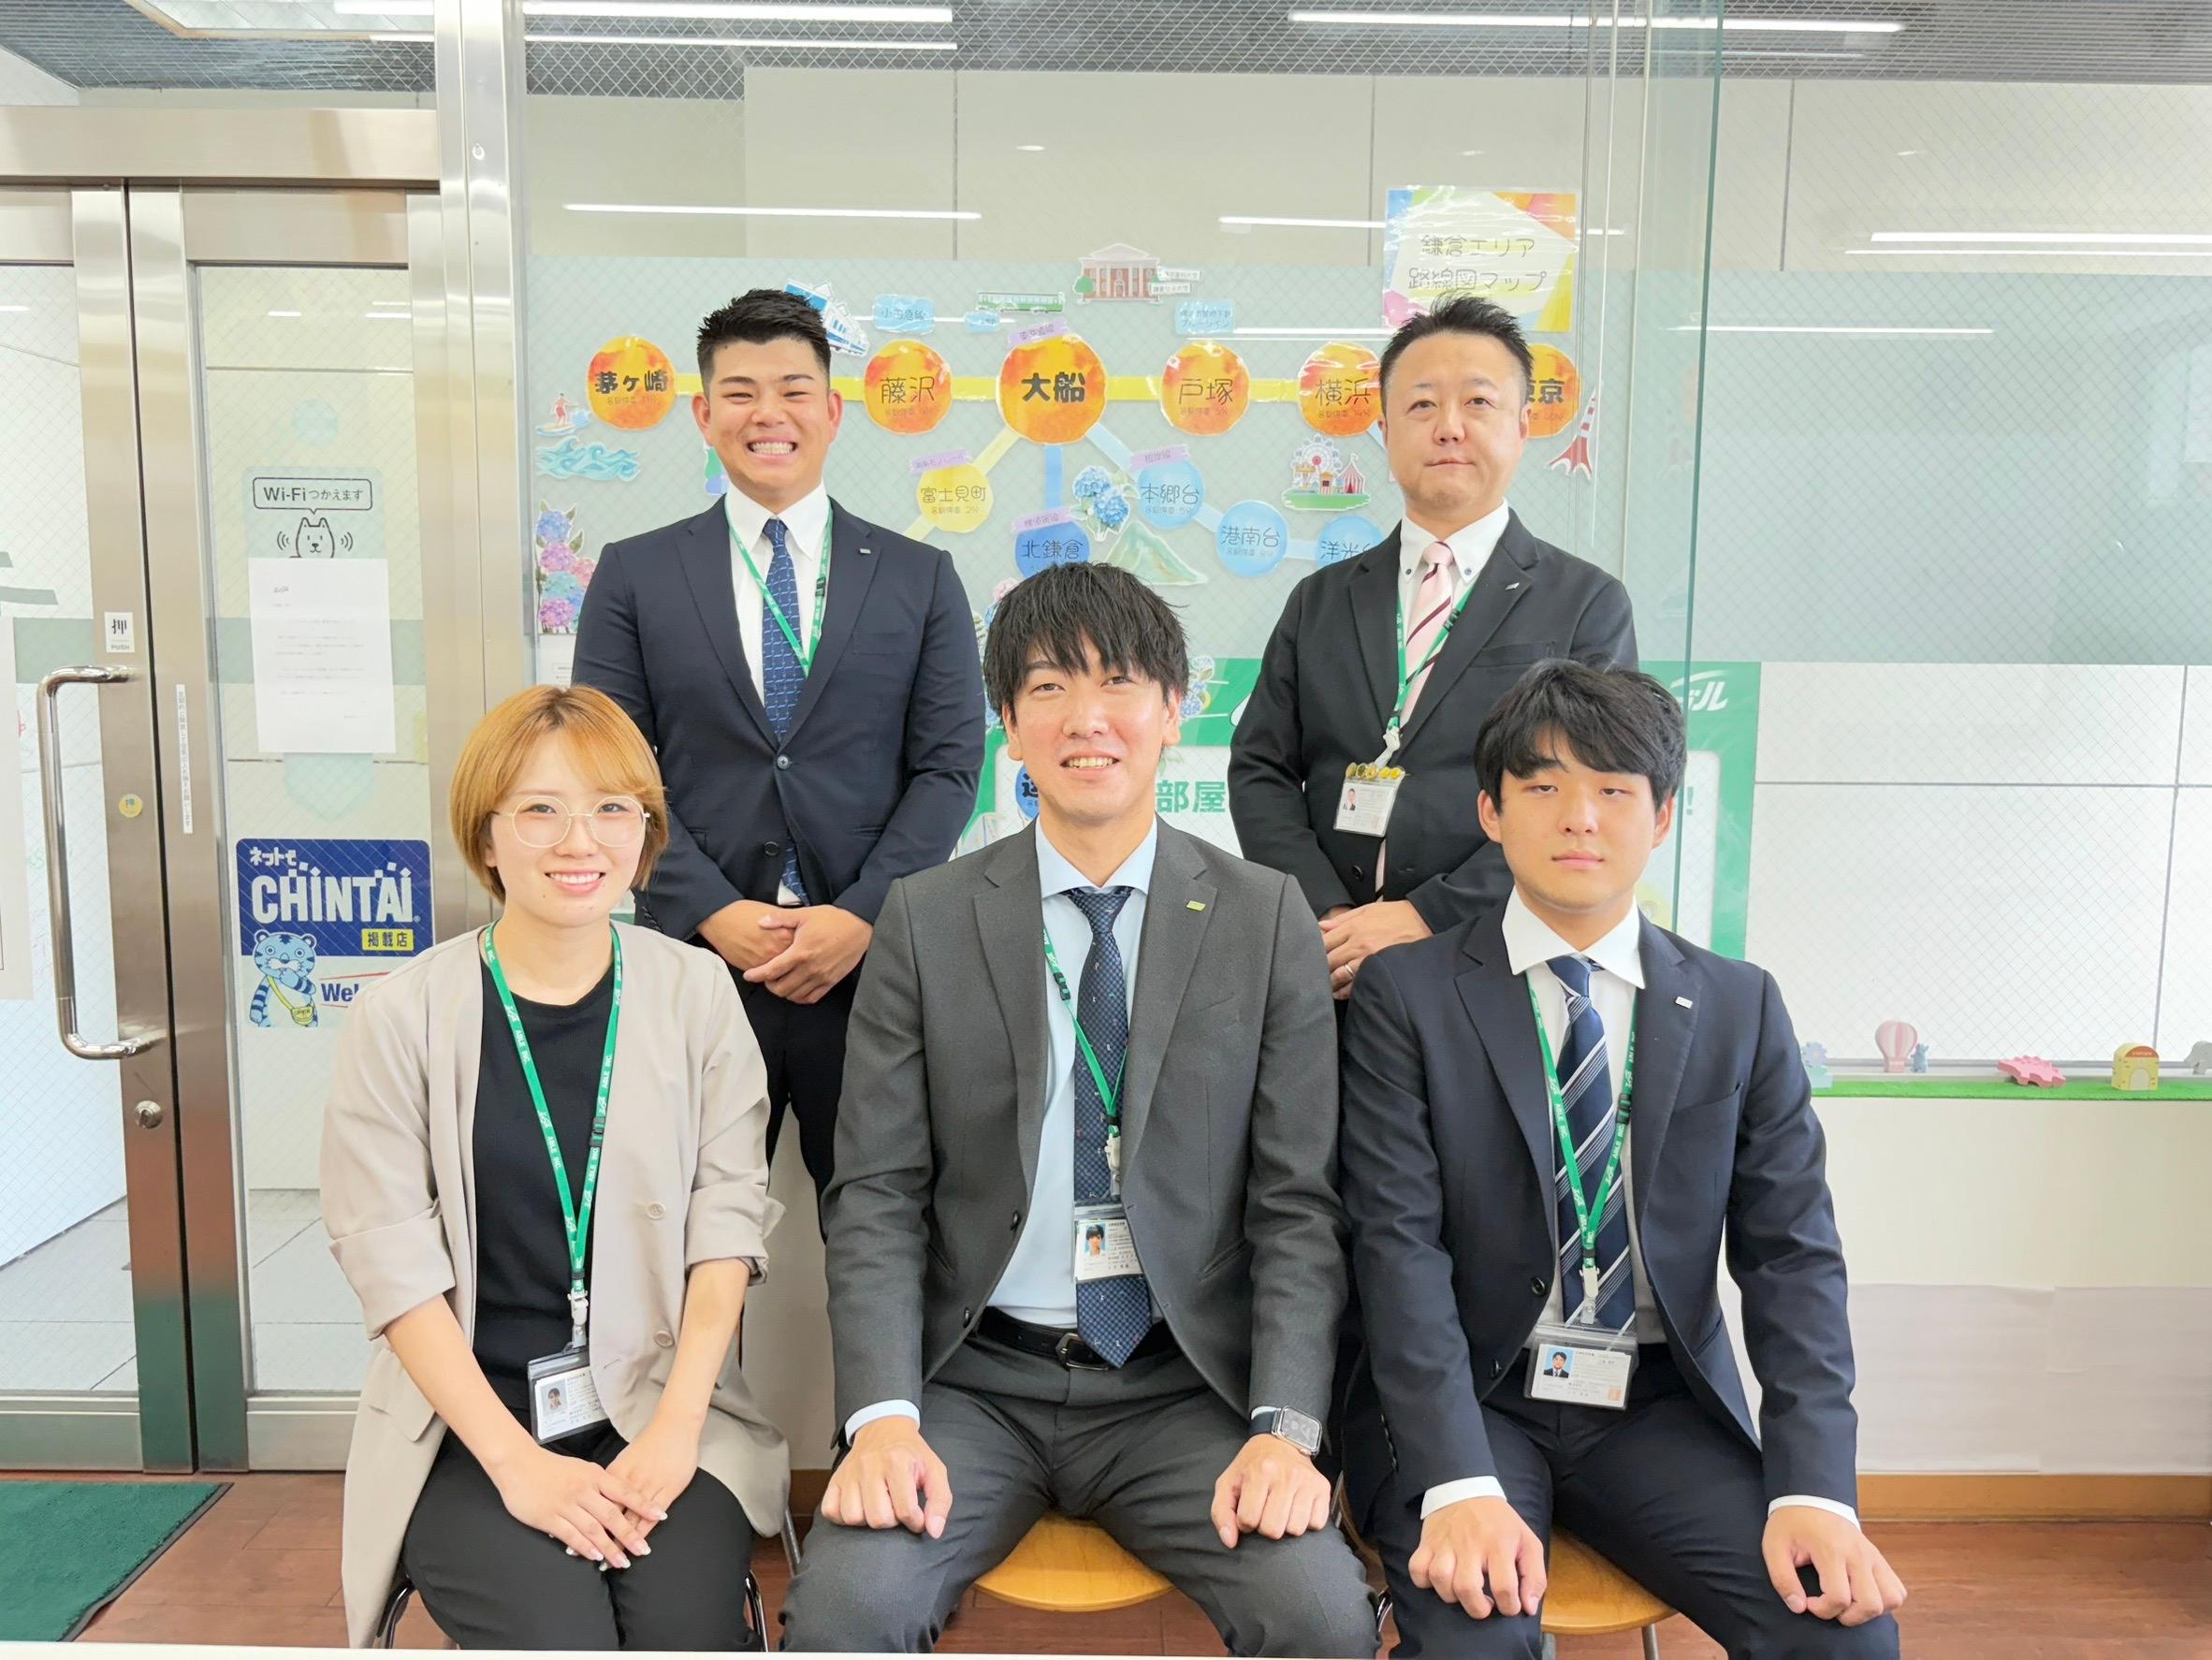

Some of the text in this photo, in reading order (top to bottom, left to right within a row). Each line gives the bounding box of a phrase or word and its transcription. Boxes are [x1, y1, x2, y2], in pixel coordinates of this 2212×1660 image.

[1419, 234, 1536, 258] 鎌倉エリア
[1407, 267, 1549, 293] 路線図マップ
[880, 375, 935, 404] 藤沢
[1020, 371, 1086, 404] 大船
[1178, 378, 1234, 406] 戸塚
[1315, 377, 1372, 407] 横浜
[263, 487, 365, 502] Wi-Fi つかえます
[920, 486, 986, 503] 富士見町
[1140, 482, 1200, 505] 本郷台
[1221, 525, 1281, 548] 港南台
[1021, 538, 1084, 561] 北鎌倉
[111, 618, 128, 635] 押
[250, 847, 298, 866] ネットで
[252, 864, 414, 925] CHINTAI
[367, 932, 409, 948] 掲載店
[516, 1029, 525, 1048] ABLE
[547, 1135, 557, 1154] ABLE
